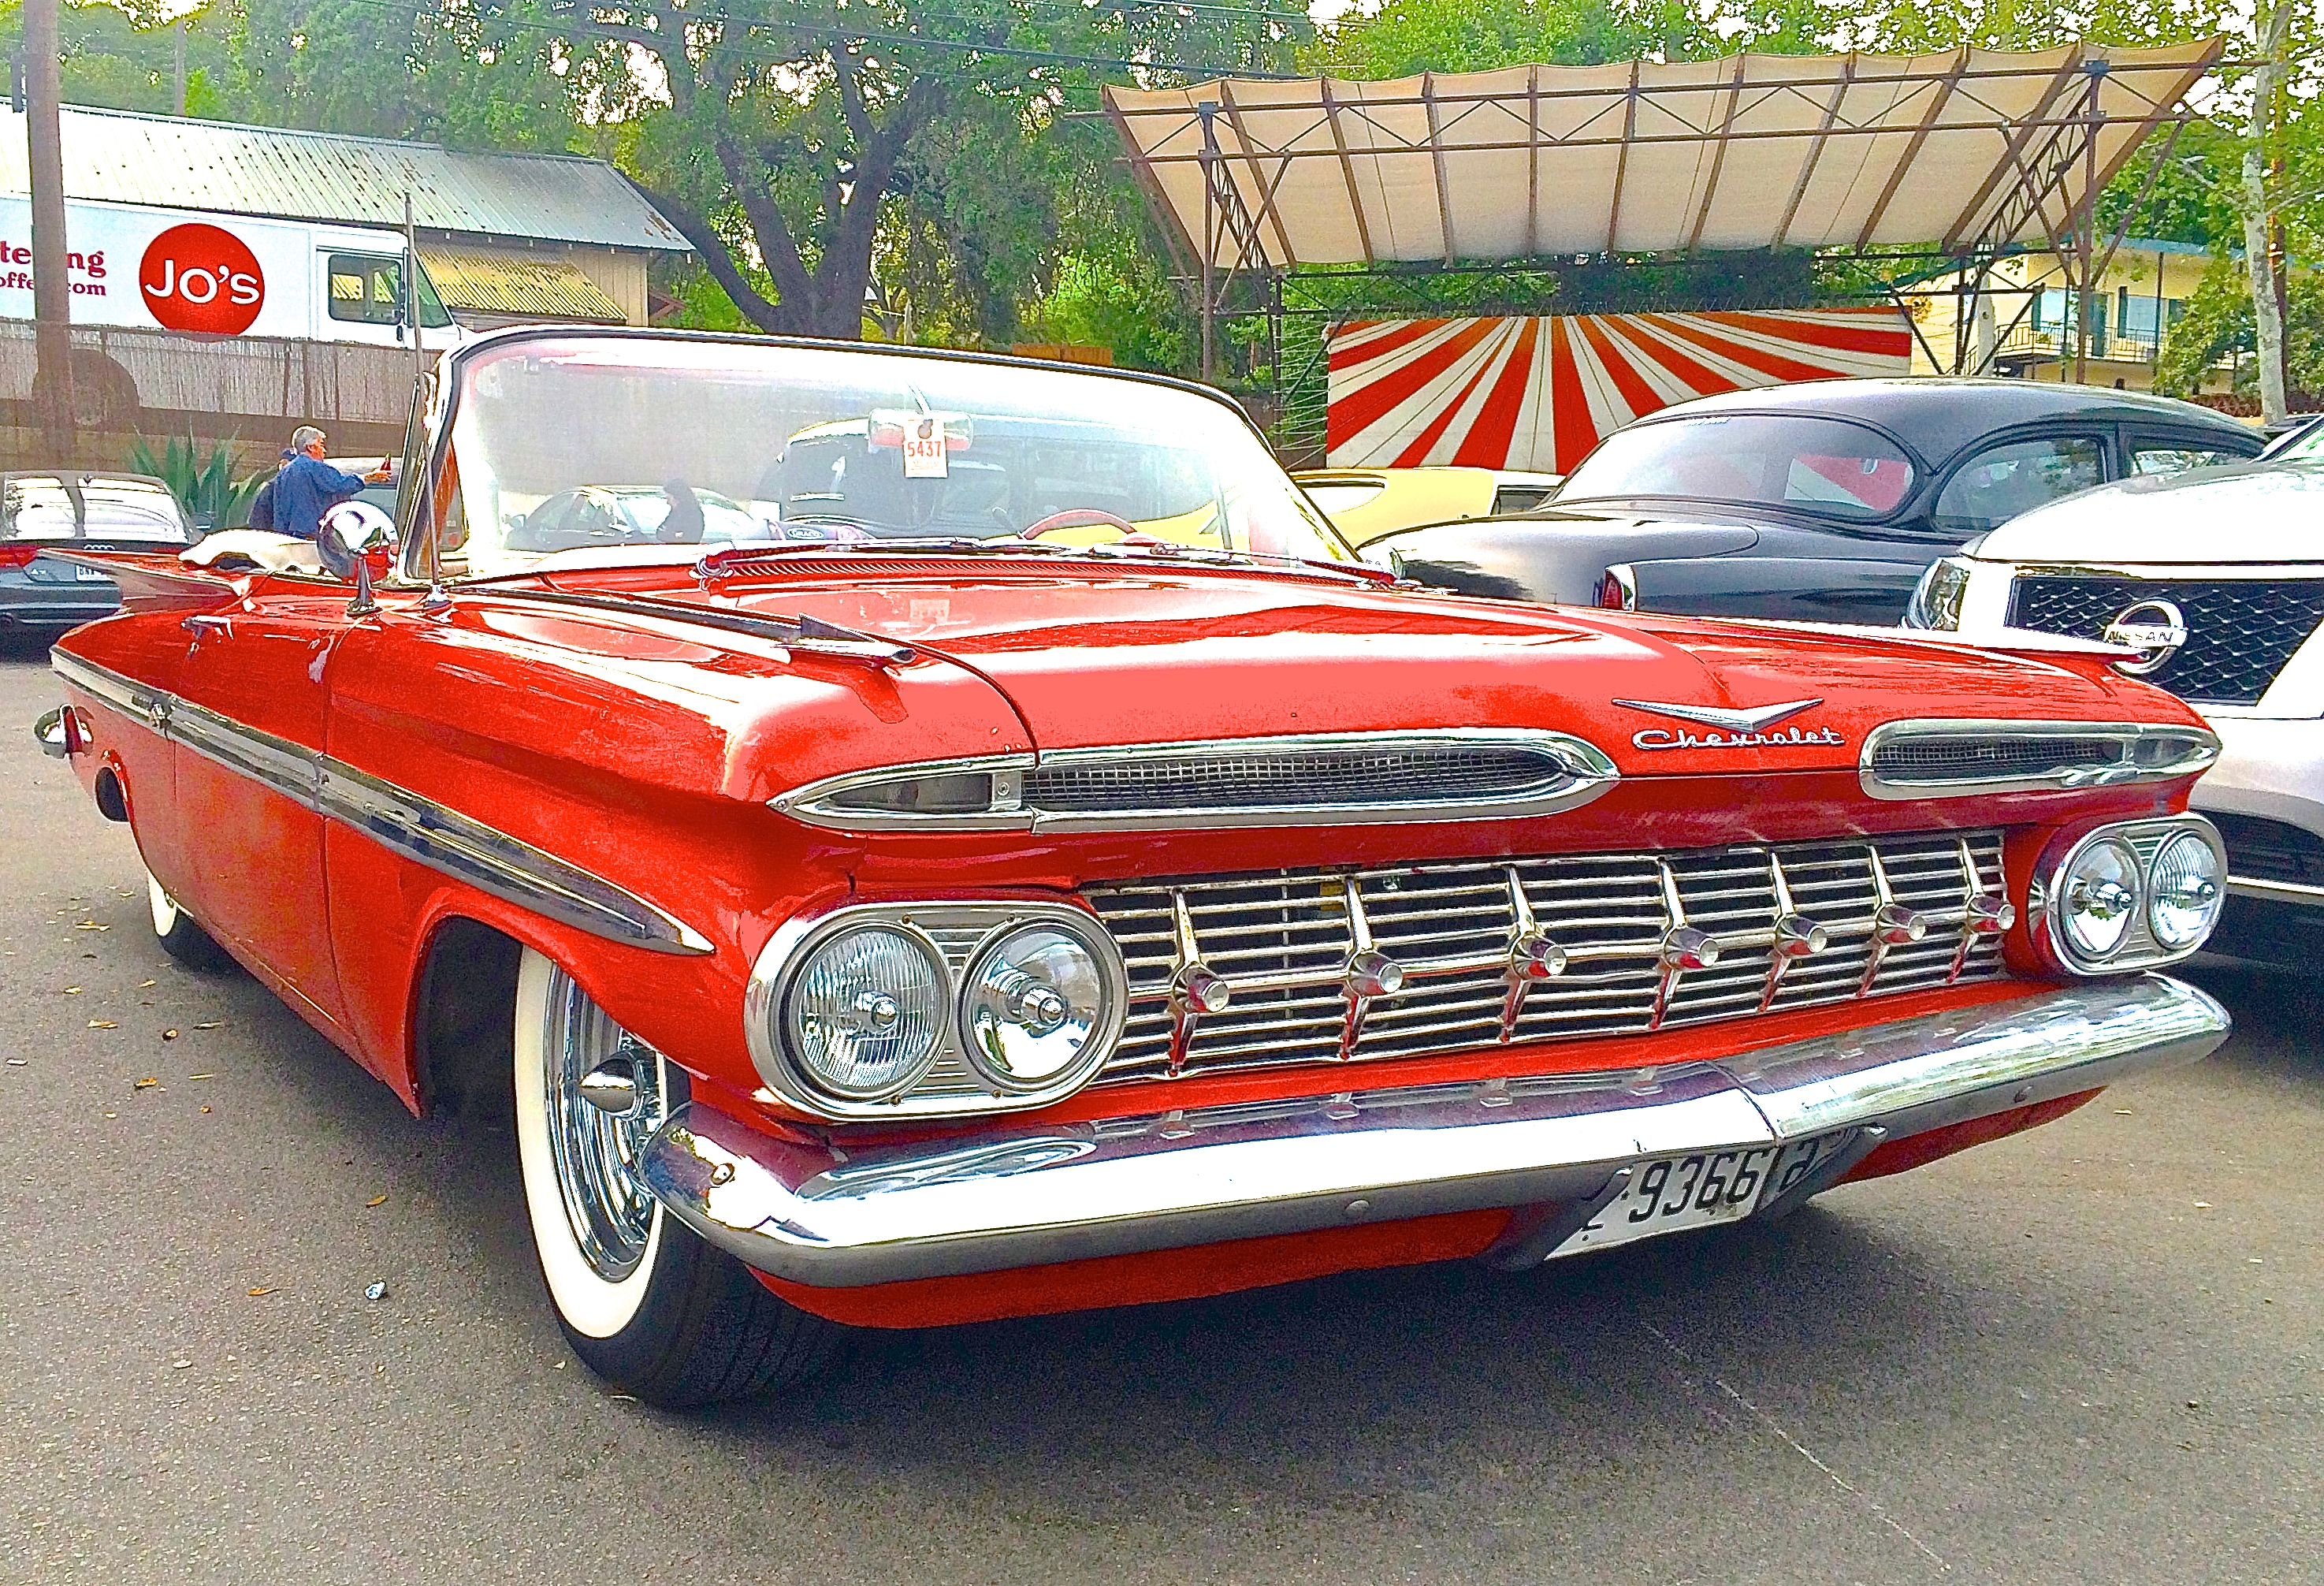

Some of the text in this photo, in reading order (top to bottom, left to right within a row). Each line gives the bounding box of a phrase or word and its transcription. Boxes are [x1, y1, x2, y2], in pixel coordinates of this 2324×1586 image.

[0, 240, 106, 278] teng
[907, 441, 942, 457] 5437
[1632, 727, 1845, 750] Chevrolet
